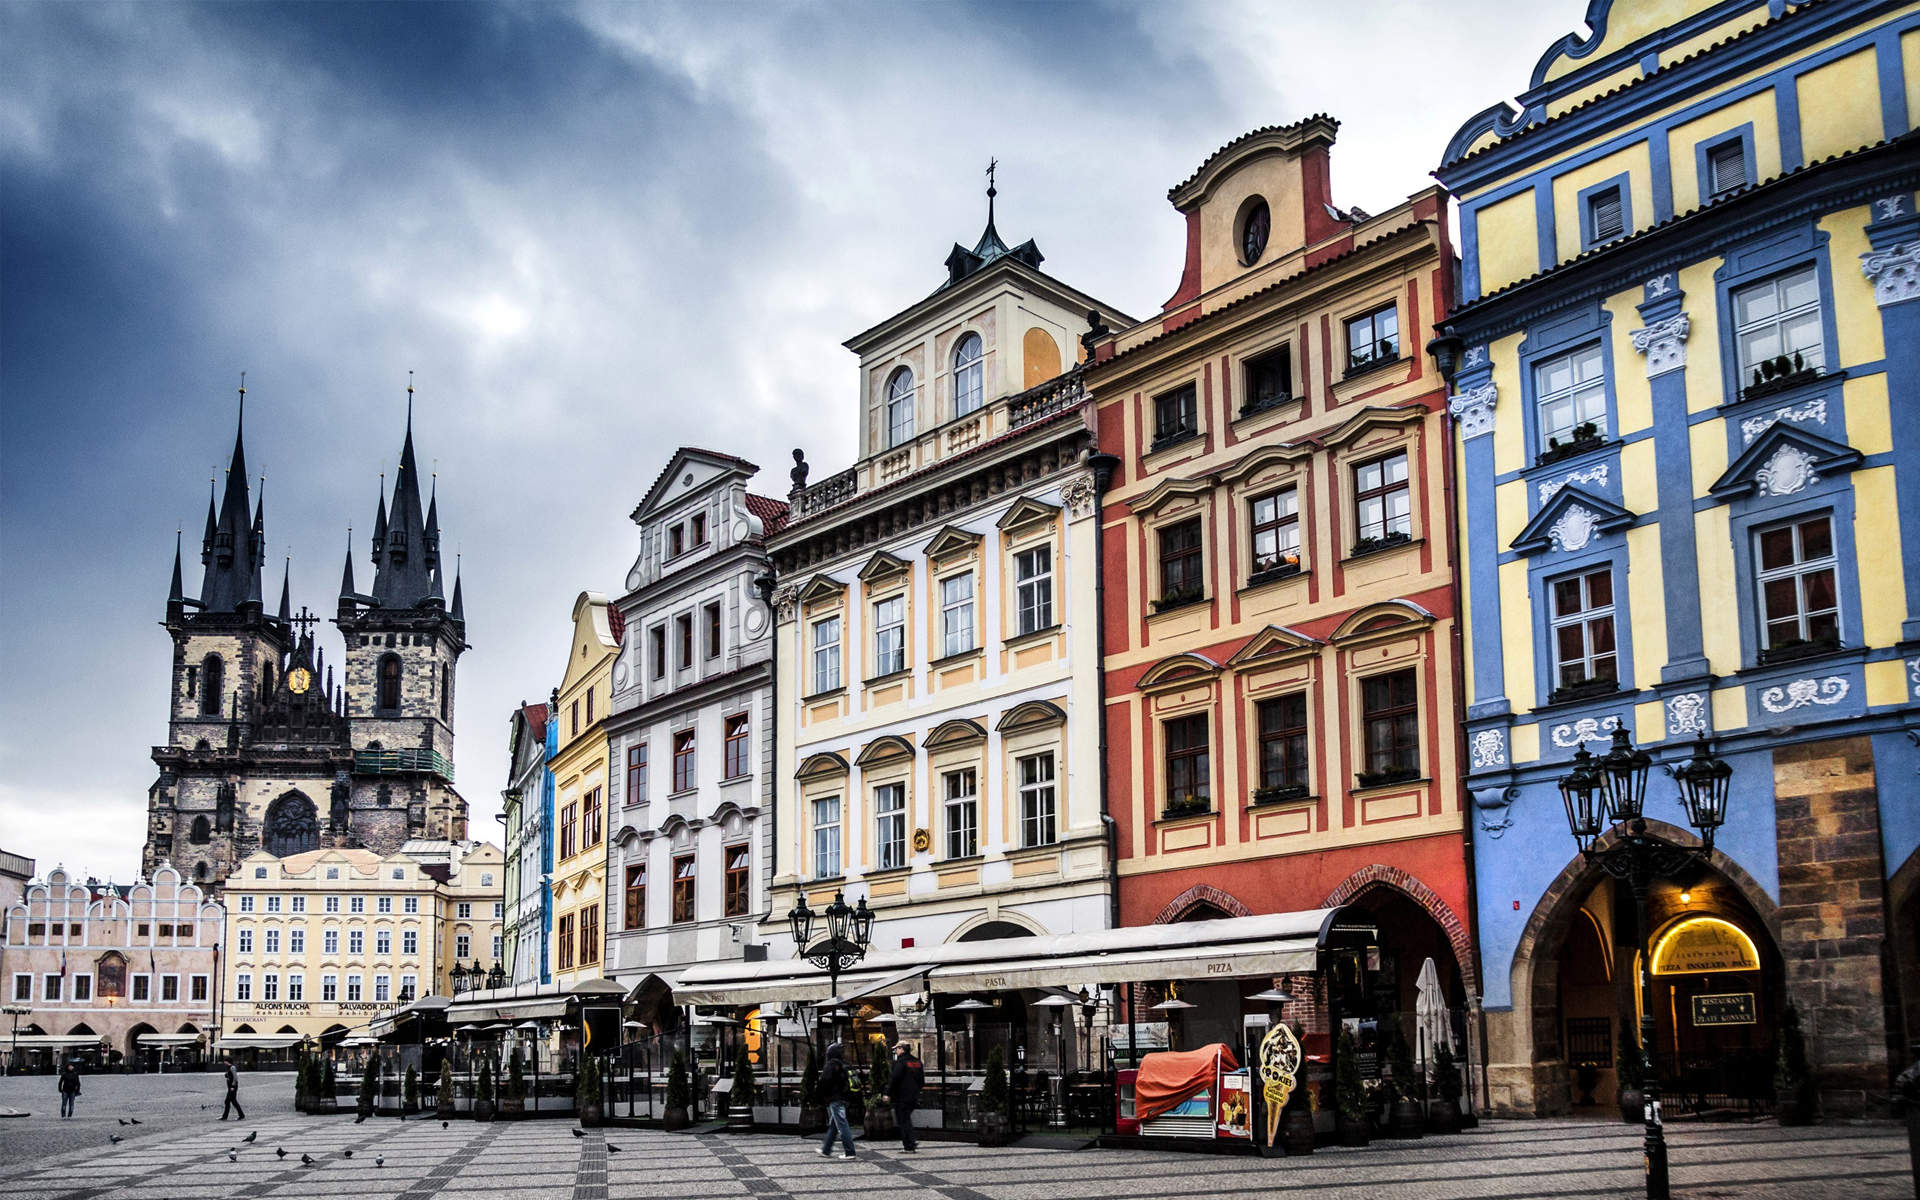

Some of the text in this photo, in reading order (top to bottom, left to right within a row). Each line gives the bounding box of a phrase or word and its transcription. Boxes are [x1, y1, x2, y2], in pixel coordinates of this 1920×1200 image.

[1208, 962, 1233, 974] PIZZA
[984, 977, 1007, 988] PASTA
[338, 1002, 378, 1010] SALVADOR
